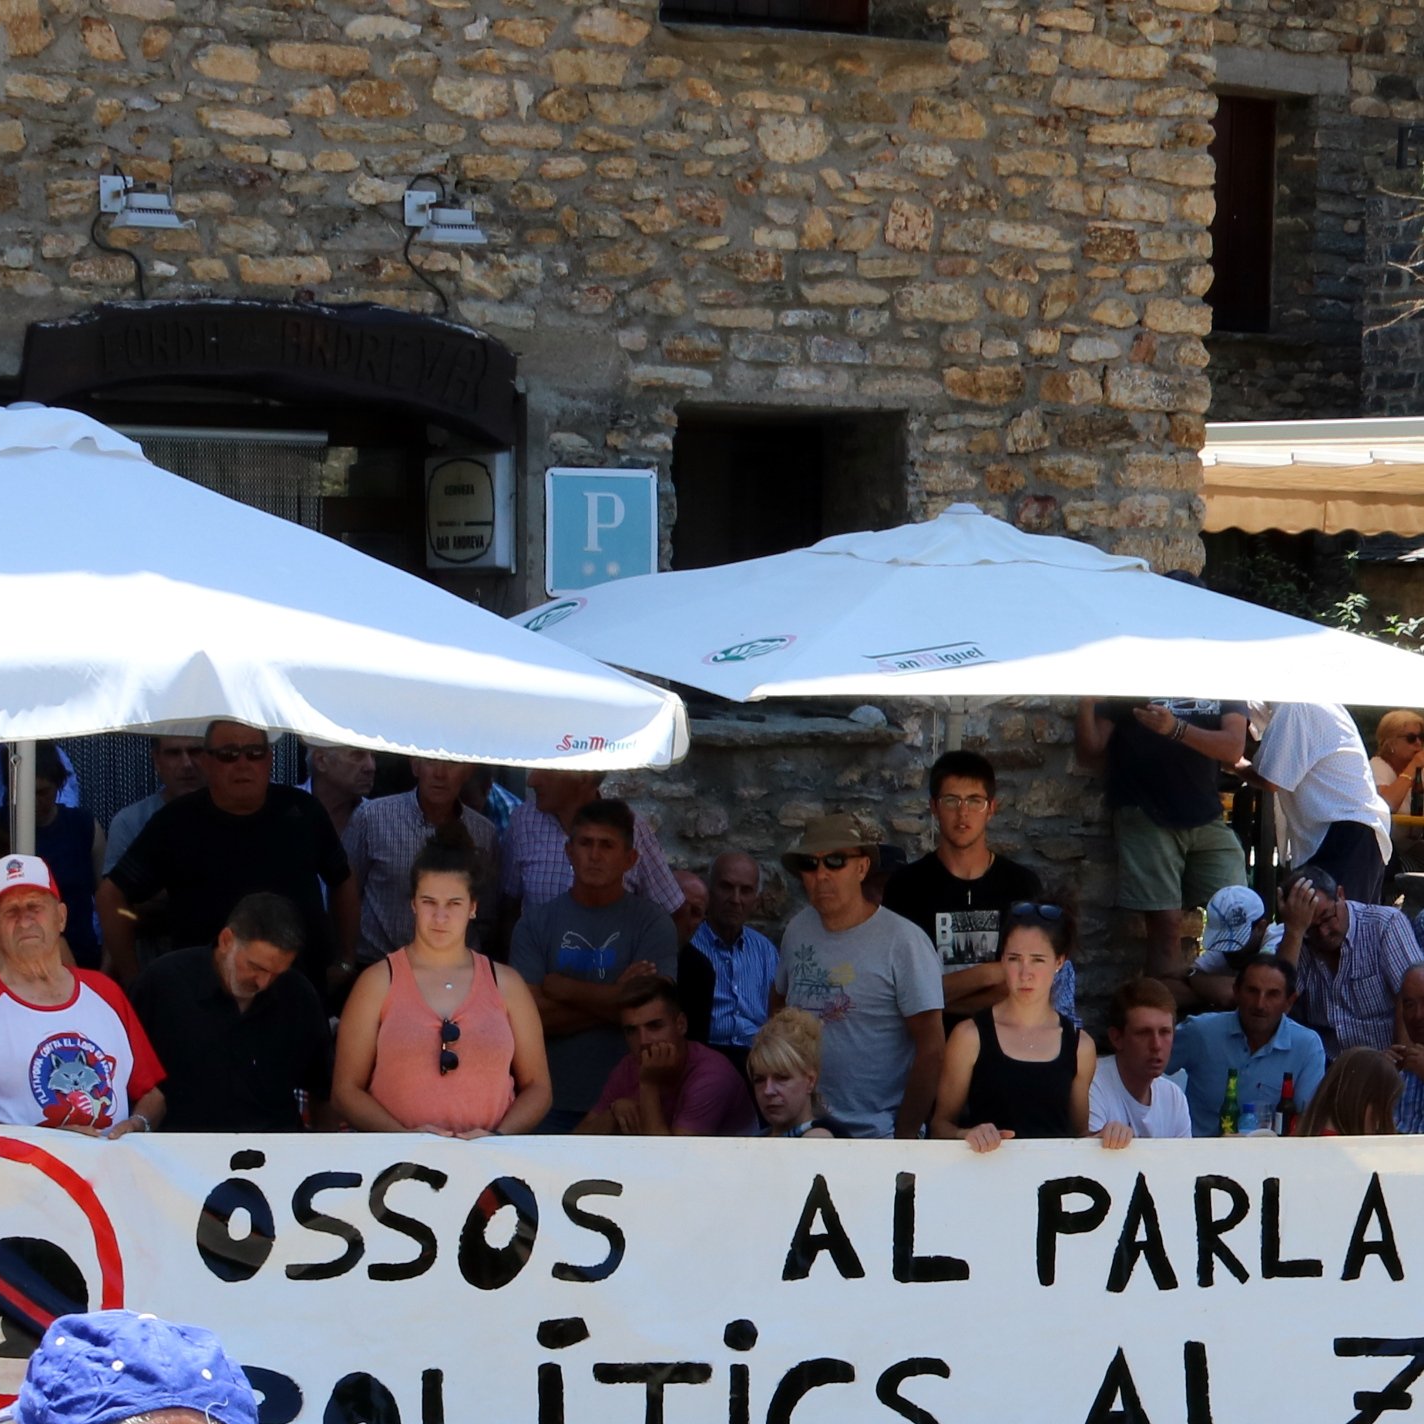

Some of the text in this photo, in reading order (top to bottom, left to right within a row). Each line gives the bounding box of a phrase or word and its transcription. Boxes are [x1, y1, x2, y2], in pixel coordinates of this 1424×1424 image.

[583, 491, 626, 552] P
[197, 1149, 626, 1290] ÓSSOS
[782, 1172, 969, 1284] AL
